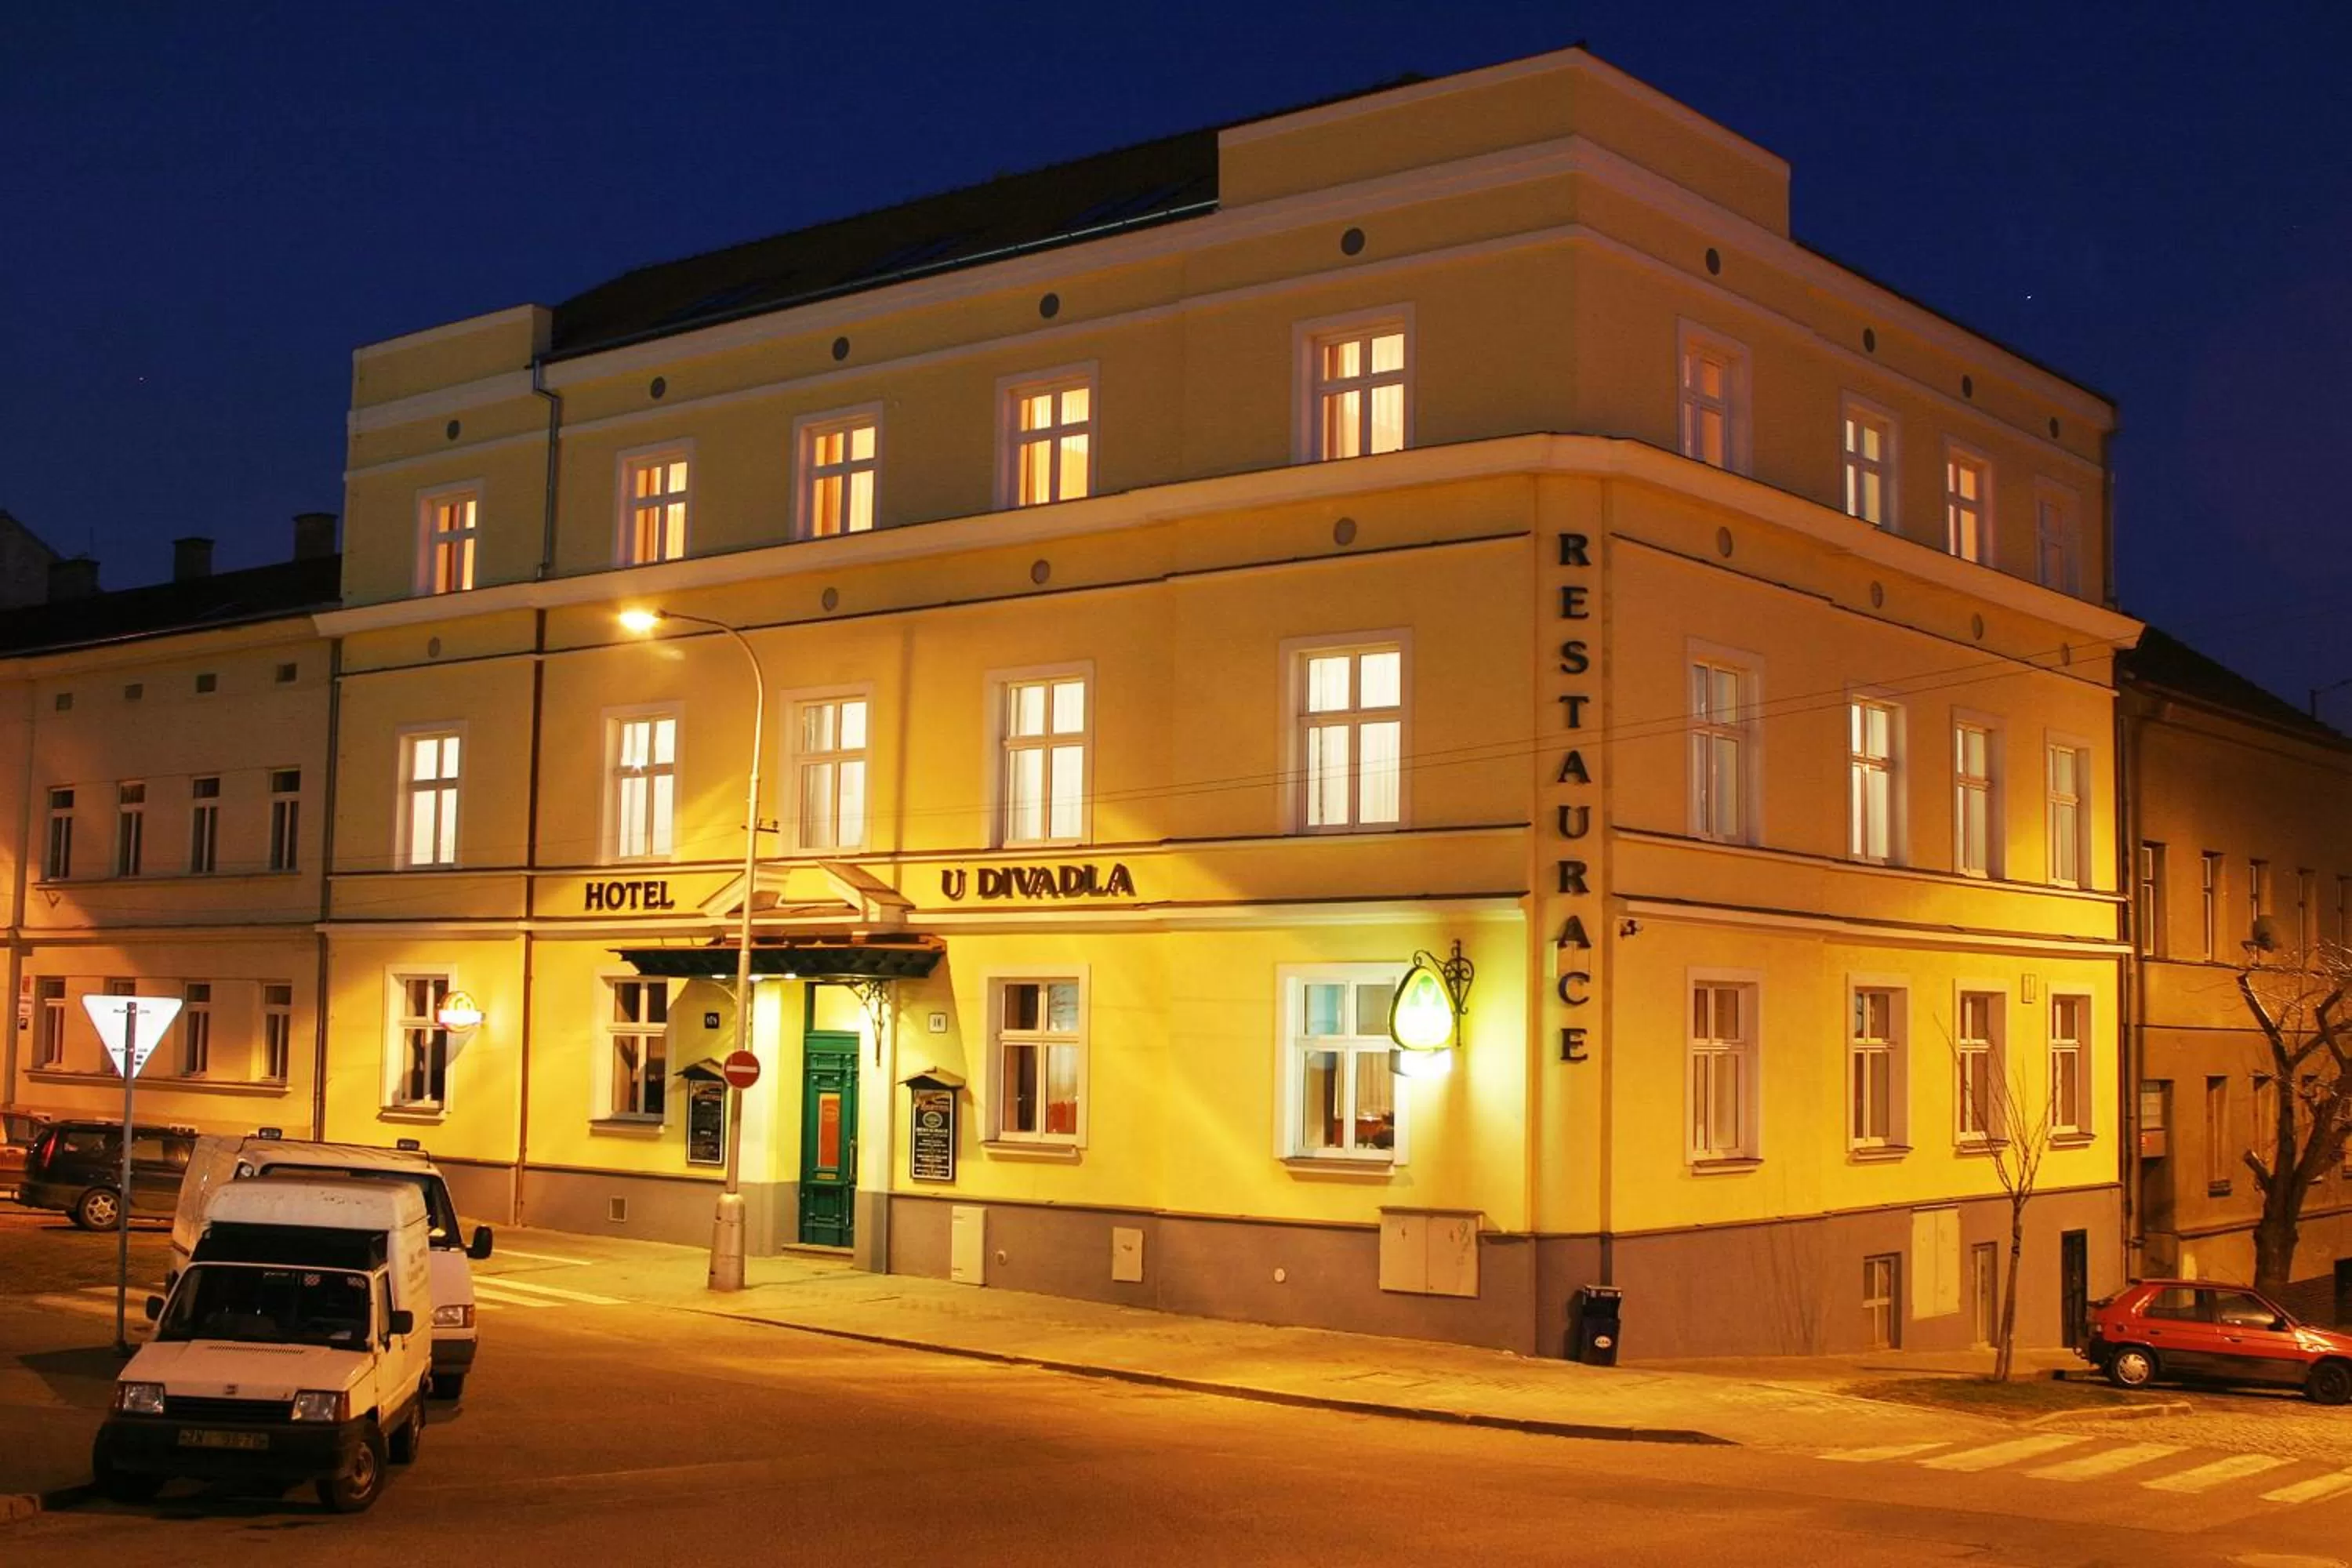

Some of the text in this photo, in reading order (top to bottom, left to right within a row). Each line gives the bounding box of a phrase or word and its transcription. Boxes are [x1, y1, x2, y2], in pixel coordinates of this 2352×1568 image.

[1558, 532, 1592, 1064] RESTAURACE
[585, 881, 675, 911] HOTEL
[942, 863, 1137, 901] U DIVADLA
